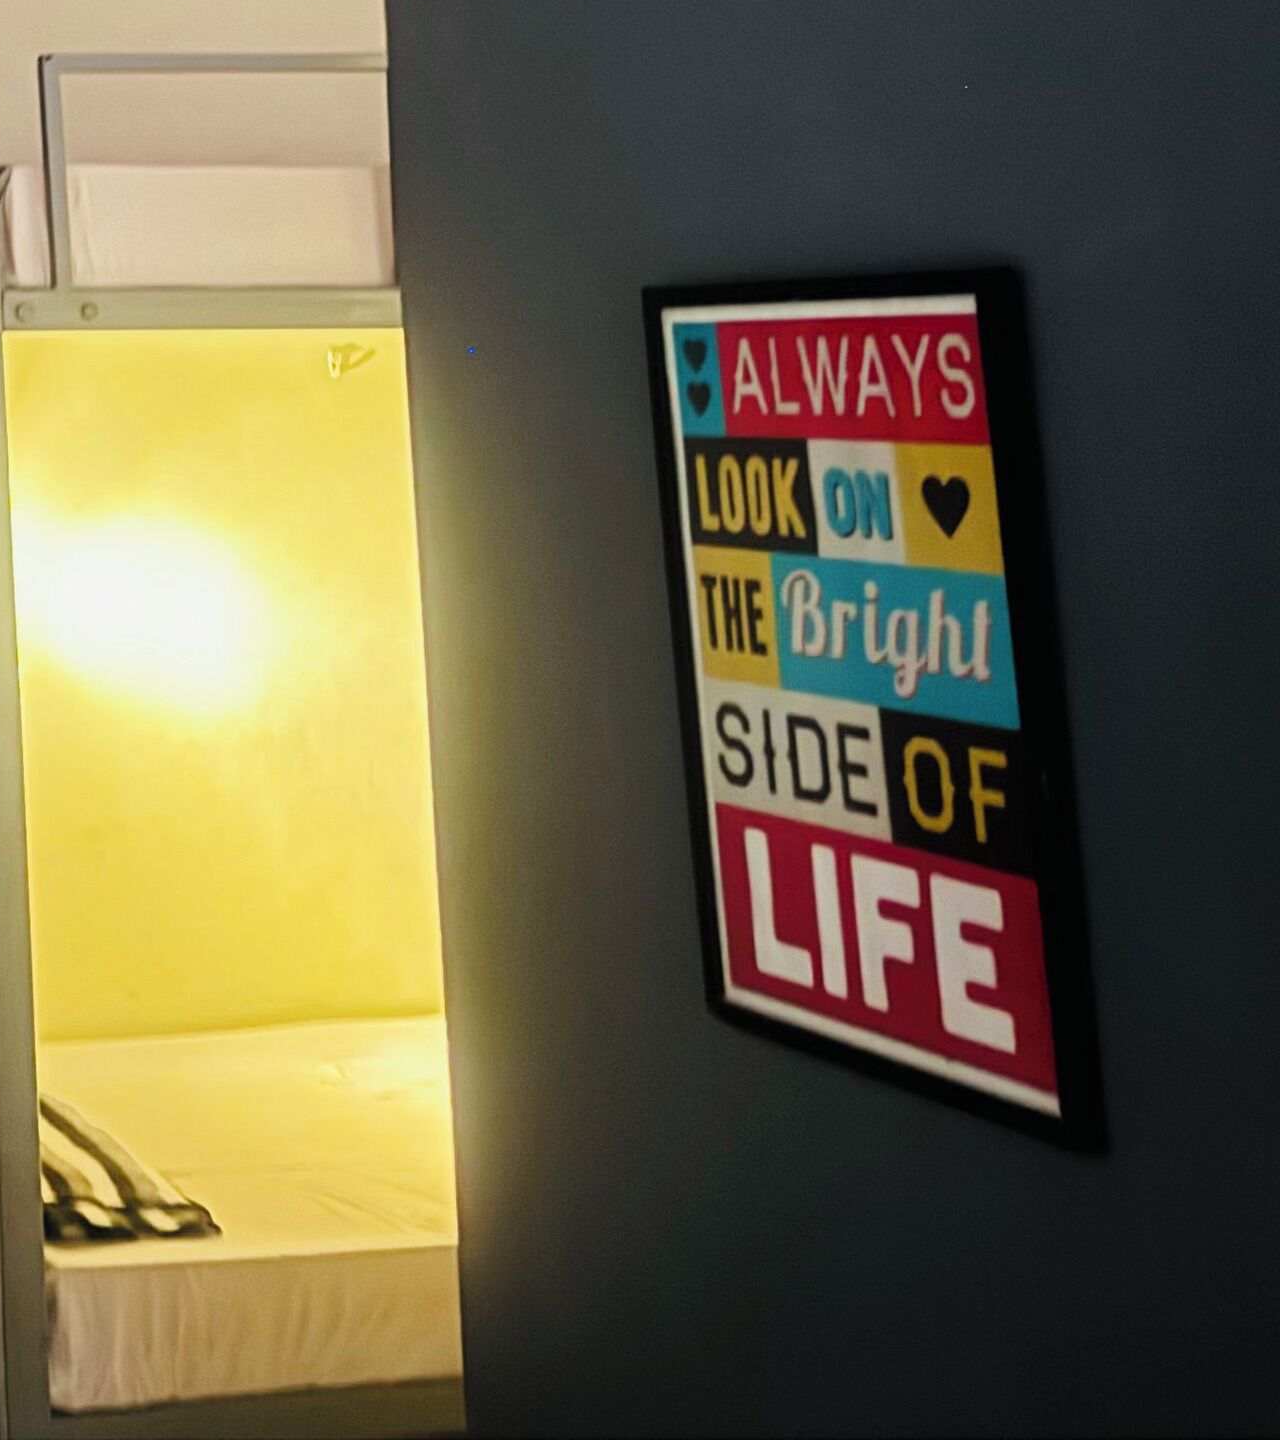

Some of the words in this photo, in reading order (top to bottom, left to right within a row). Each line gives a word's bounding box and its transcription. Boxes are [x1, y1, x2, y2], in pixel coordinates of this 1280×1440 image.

[732, 333, 976, 419] ALWAYS
[696, 452, 806, 539] LOOK
[823, 467, 894, 540] ON
[701, 573, 768, 656] THE
[781, 569, 992, 698] Bright
[716, 703, 878, 817] SIDE
[903, 735, 1007, 844] OF
[743, 827, 1017, 1055] LIFE
